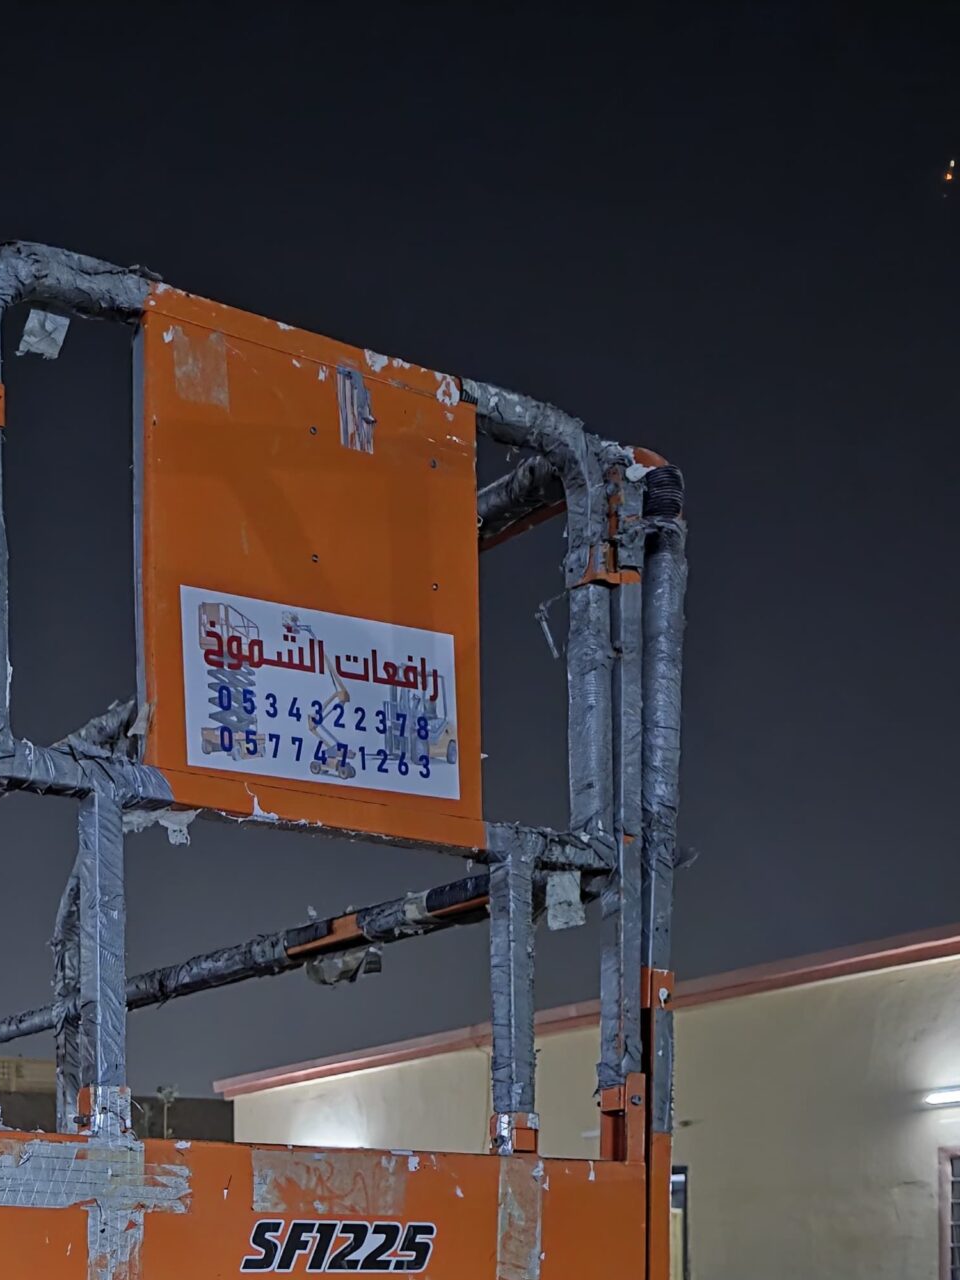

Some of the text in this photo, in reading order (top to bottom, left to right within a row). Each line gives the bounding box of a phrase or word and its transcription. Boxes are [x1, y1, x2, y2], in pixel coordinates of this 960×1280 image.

[204, 620, 438, 701] رافعات الشموخ
[240, 1219, 437, 1272] SF1225
